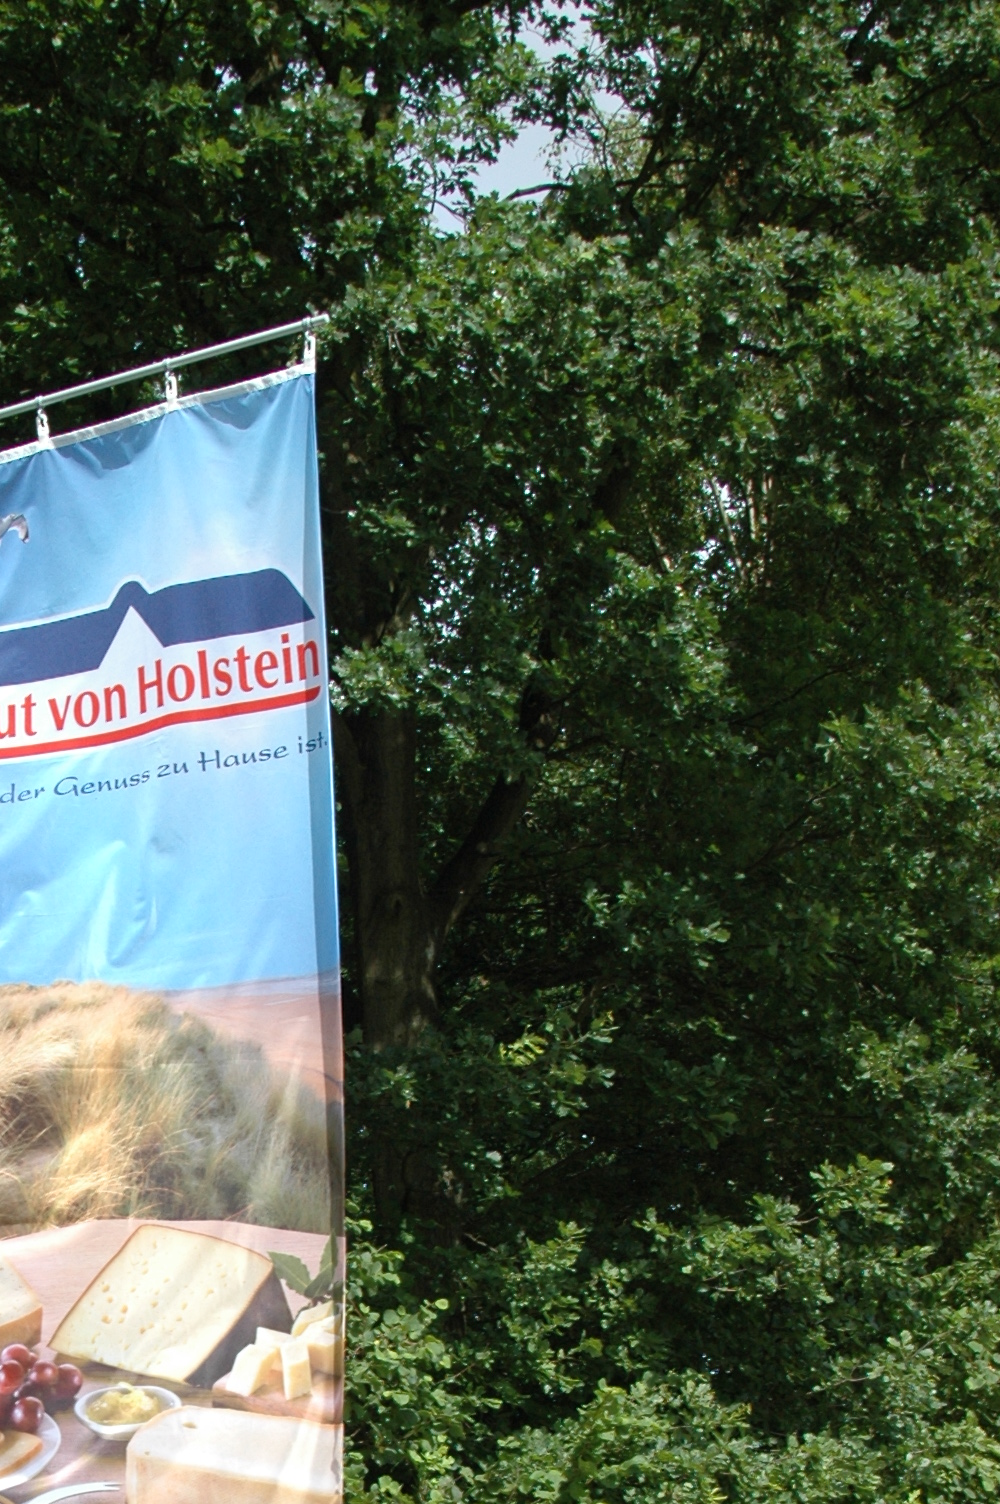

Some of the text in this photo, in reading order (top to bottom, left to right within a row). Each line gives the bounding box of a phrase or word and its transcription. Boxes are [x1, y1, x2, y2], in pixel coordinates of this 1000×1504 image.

[48, 683, 128, 732] von
[137, 633, 320, 716] Holstein
[0, 783, 45, 804] der
[53, 767, 151, 798] Genuss
[156, 756, 190, 779] zu
[197, 745, 290, 774] Hause
